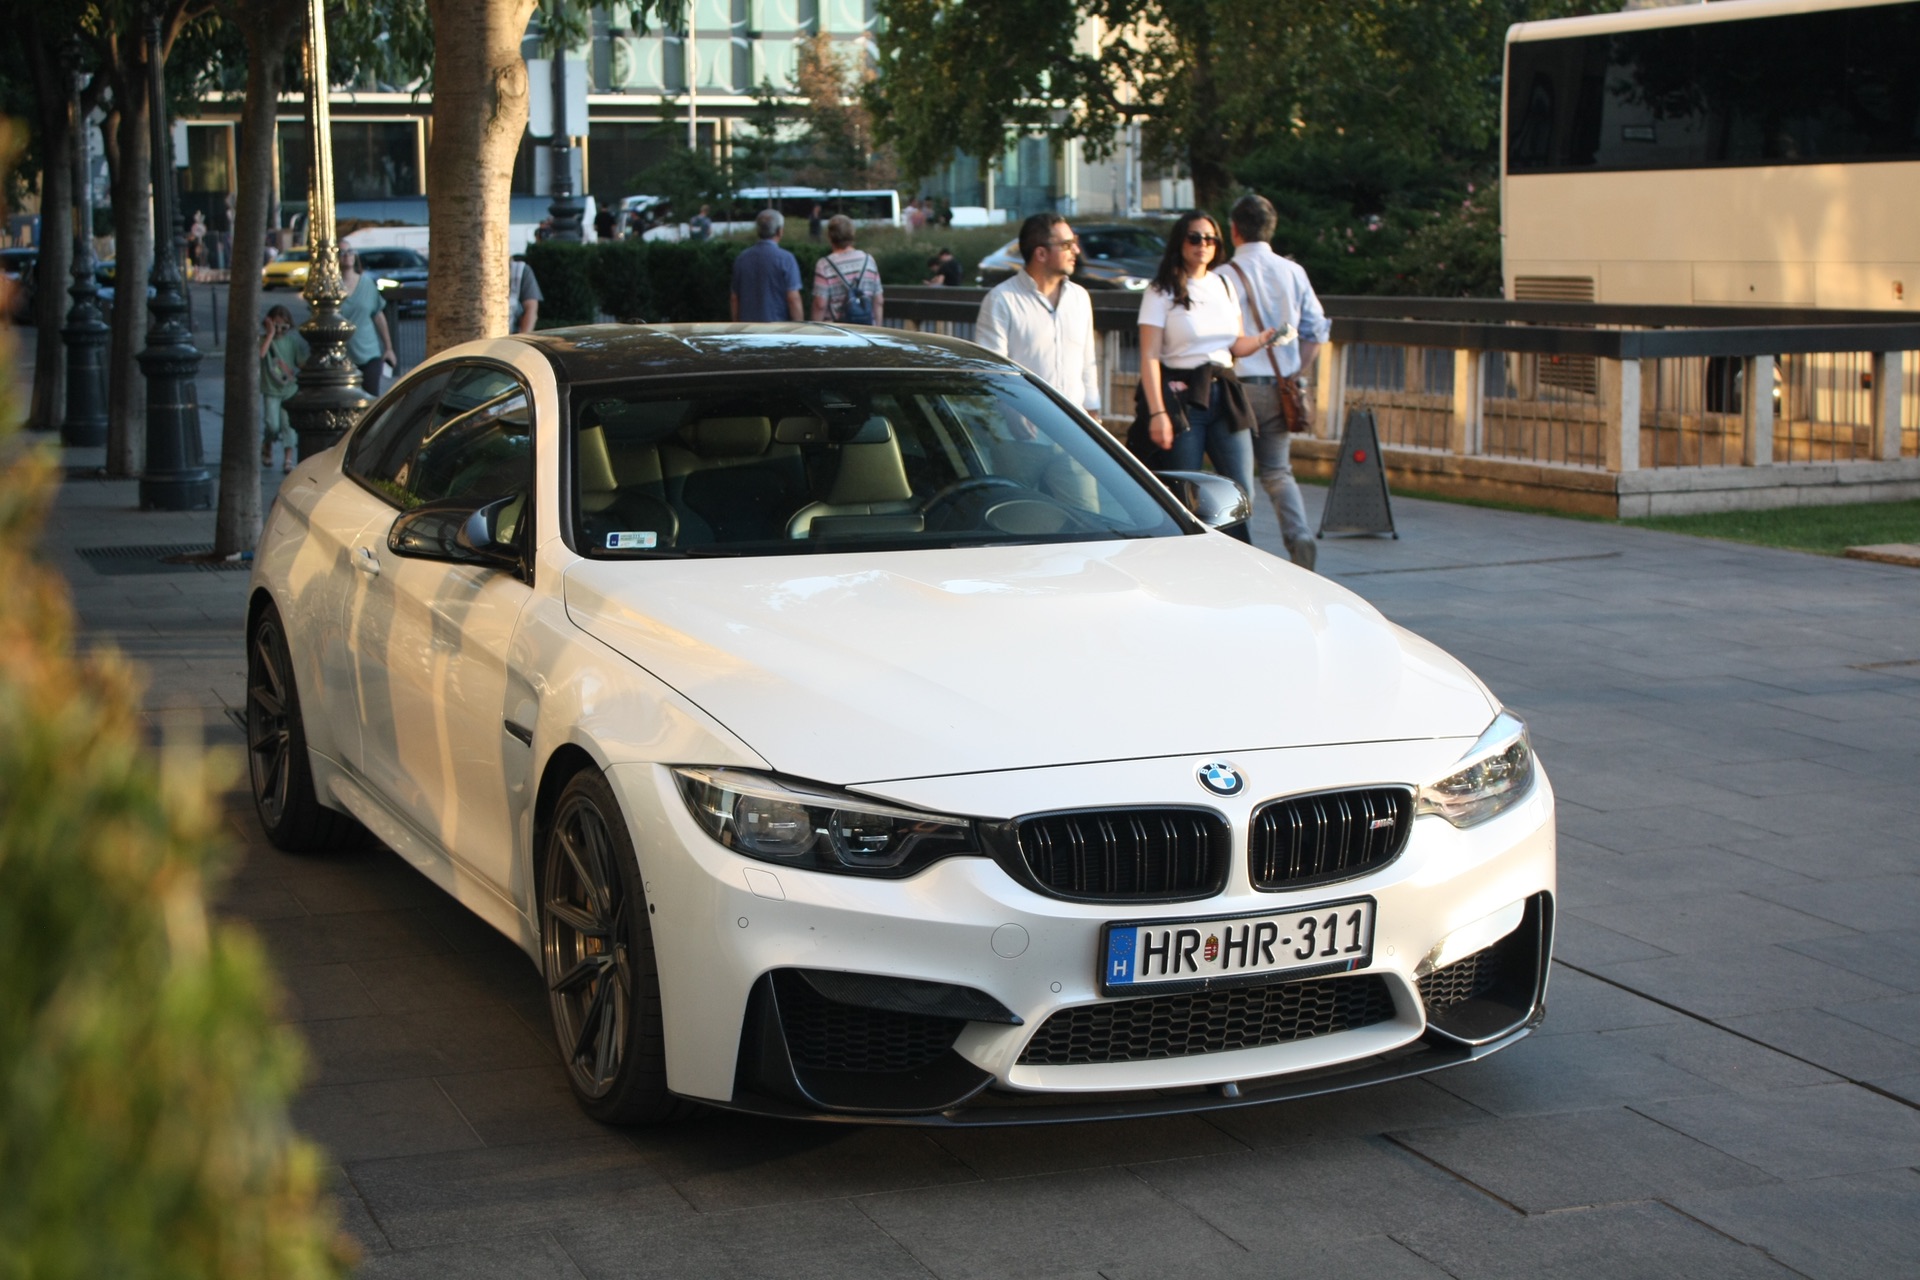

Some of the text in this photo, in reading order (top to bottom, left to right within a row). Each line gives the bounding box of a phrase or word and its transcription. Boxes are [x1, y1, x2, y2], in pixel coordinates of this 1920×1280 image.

[1200, 762, 1236, 774] BMW
[1142, 908, 1363, 976] HR HR-311
[1114, 960, 1128, 977] H
